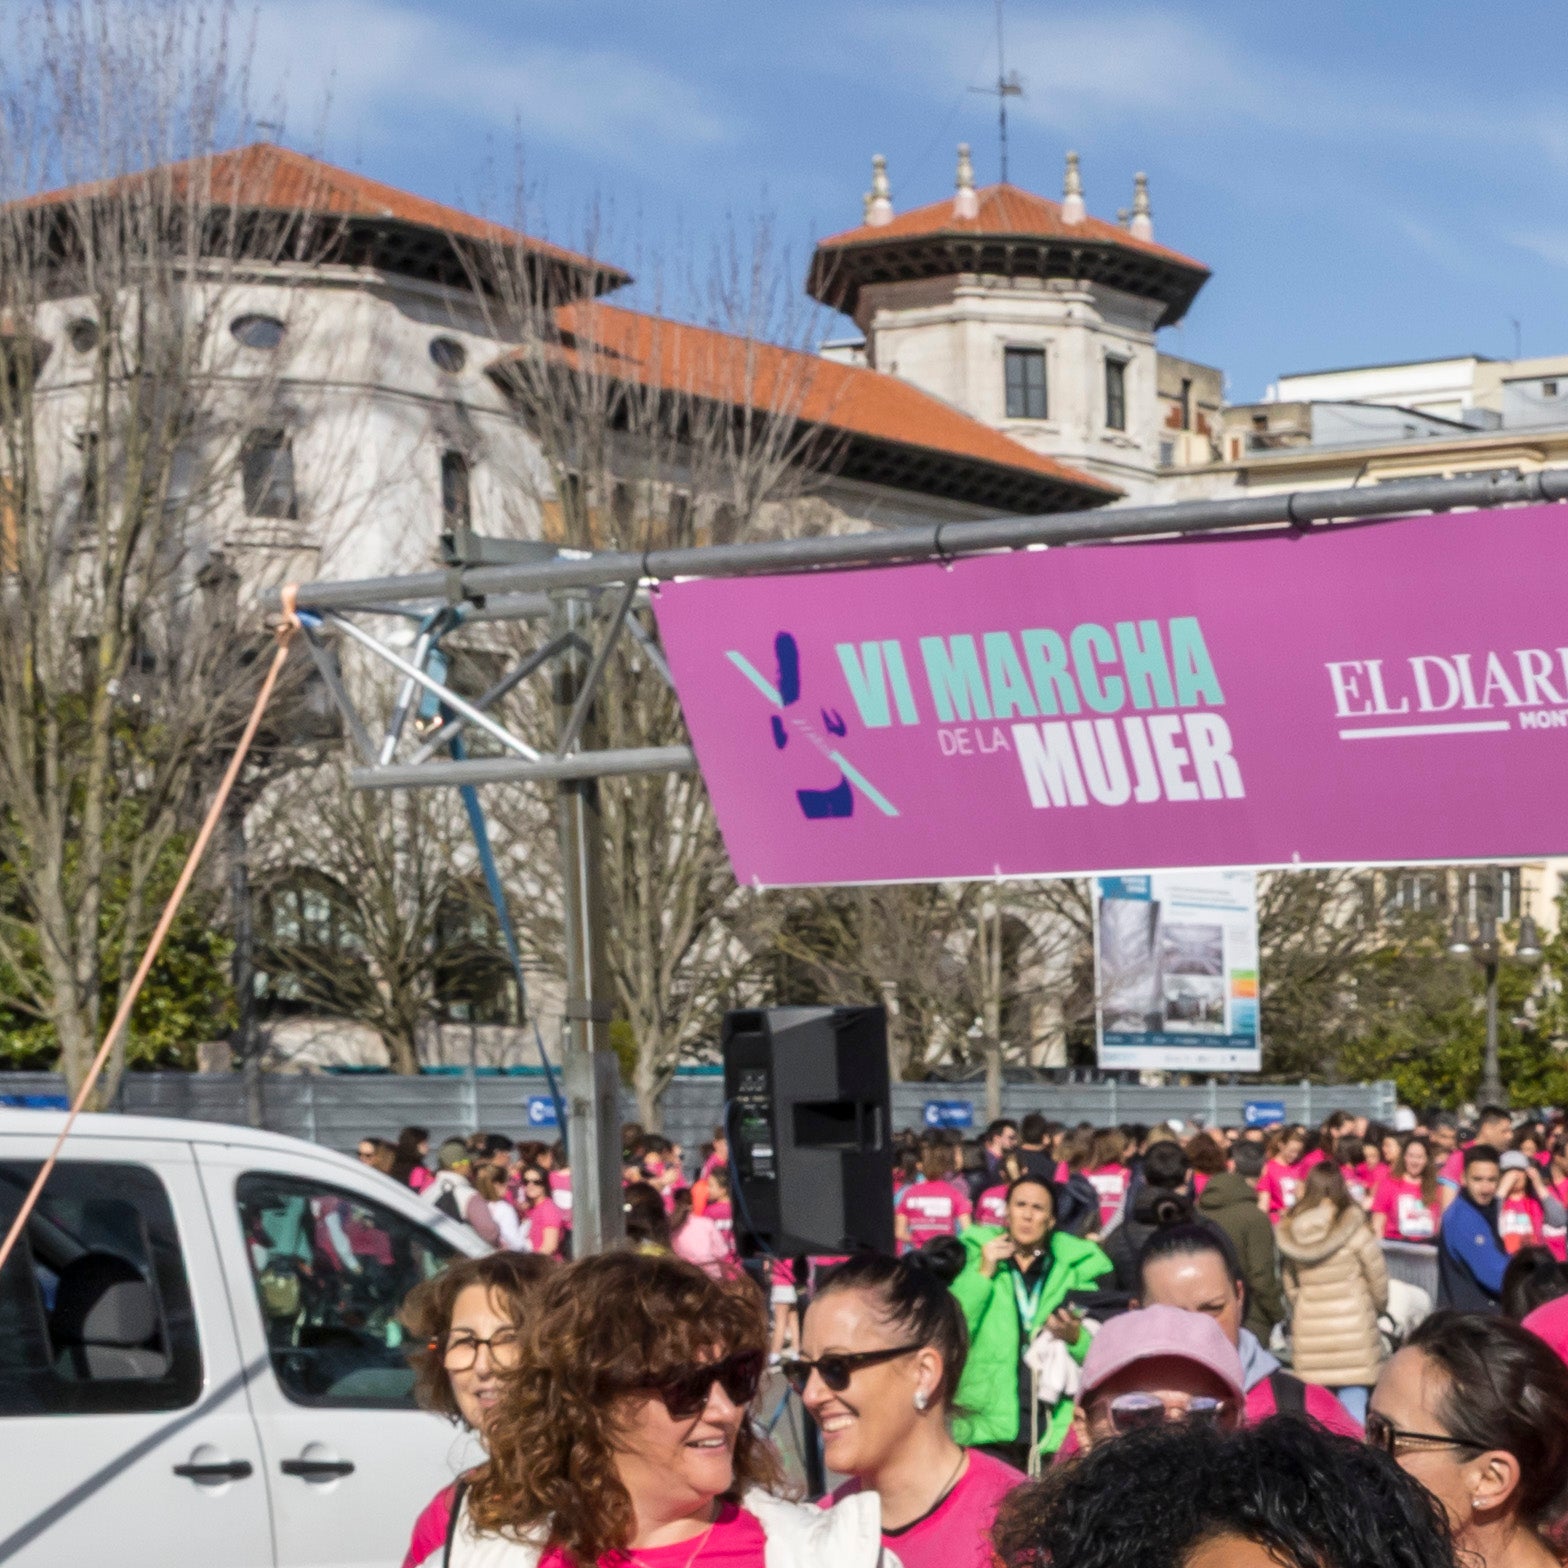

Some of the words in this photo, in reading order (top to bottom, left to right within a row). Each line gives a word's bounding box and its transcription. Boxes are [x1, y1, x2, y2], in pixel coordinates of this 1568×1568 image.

[835, 638, 920, 729] VI
[919, 615, 1225, 722] MARCHA
[1324, 659, 1409, 718] EL
[937, 727, 974, 757] DE
[978, 725, 1010, 754] LA
[1010, 711, 1246, 809] MUJER
